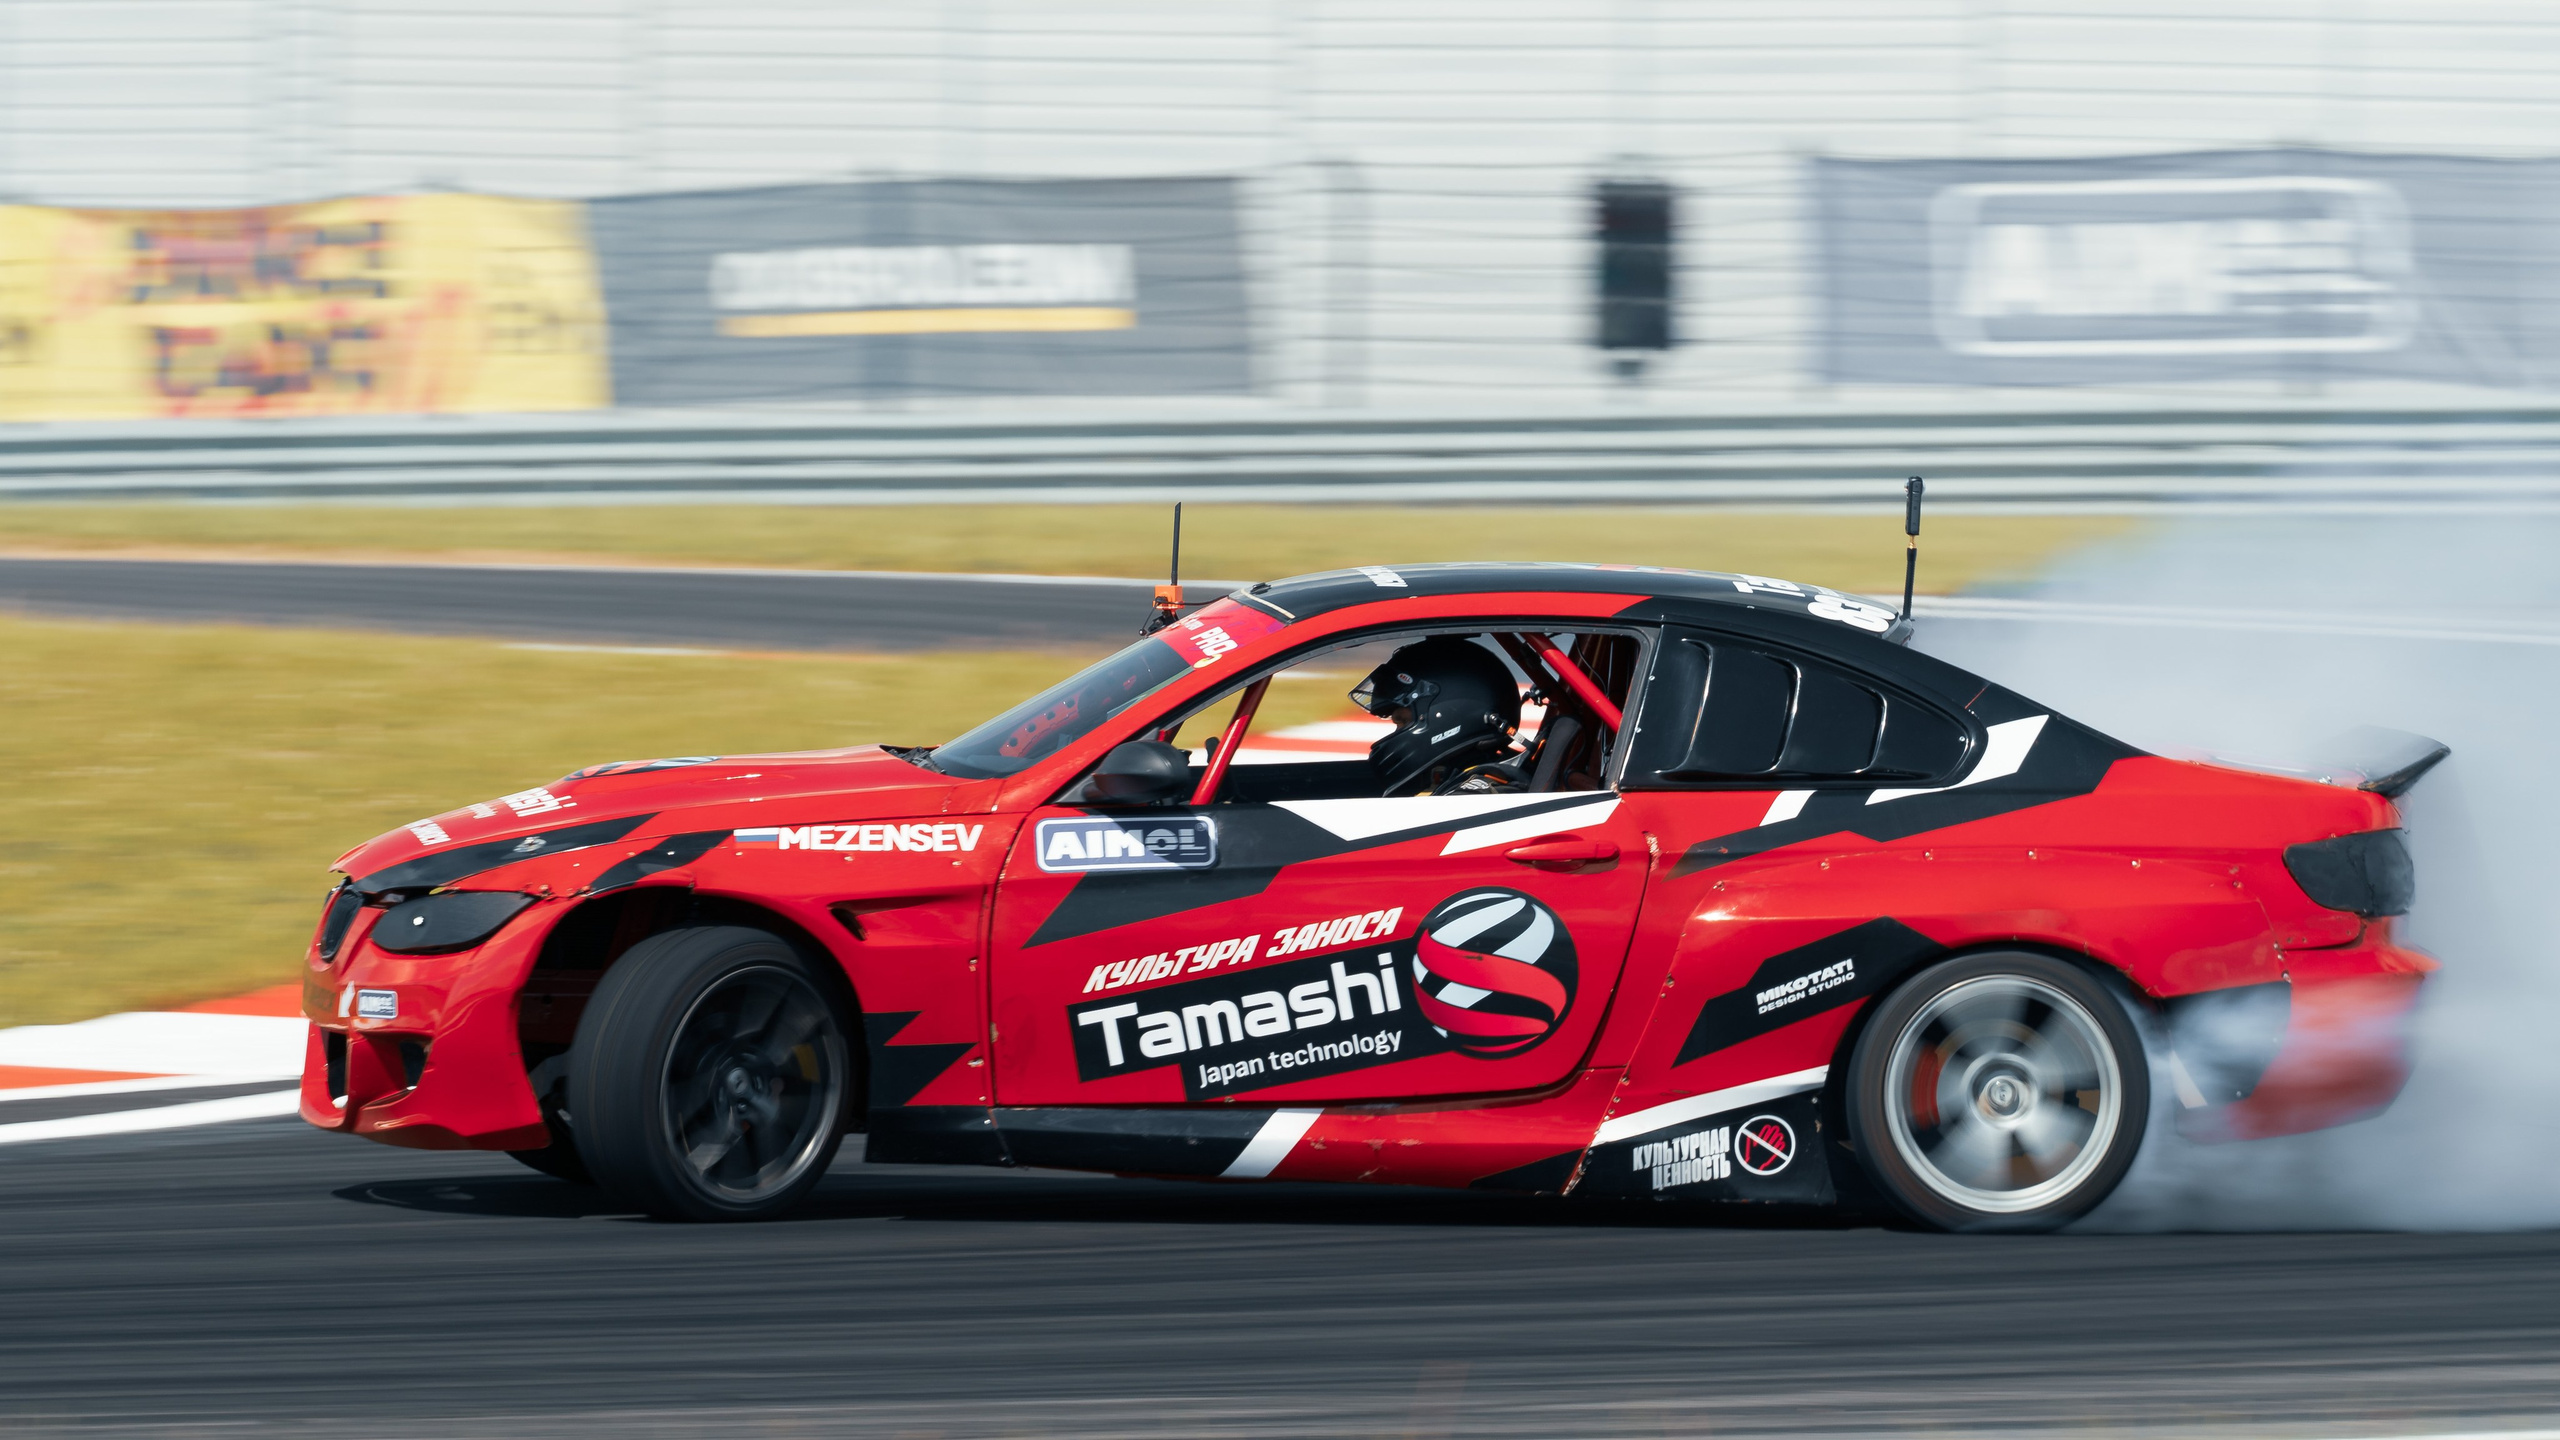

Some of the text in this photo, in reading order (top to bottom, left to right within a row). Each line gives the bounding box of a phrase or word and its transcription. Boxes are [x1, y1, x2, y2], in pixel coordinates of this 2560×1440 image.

[778, 823, 984, 852] MEZENSEV
[1045, 828, 1207, 860] AIMOL
[1082, 907, 1404, 994] КУЛЬТУРА ЗАНОСА
[1755, 957, 1854, 1006] MIKOTATI
[1758, 971, 1856, 1015] DESIGN STUDIO
[1077, 952, 1402, 1067] Tamashi
[1199, 1029, 1402, 1089] Japan technology
[1632, 1126, 1730, 1171] КУЛЬТУРНАЯ
[1652, 1152, 1732, 1191] ЦЕННОСТЬ
